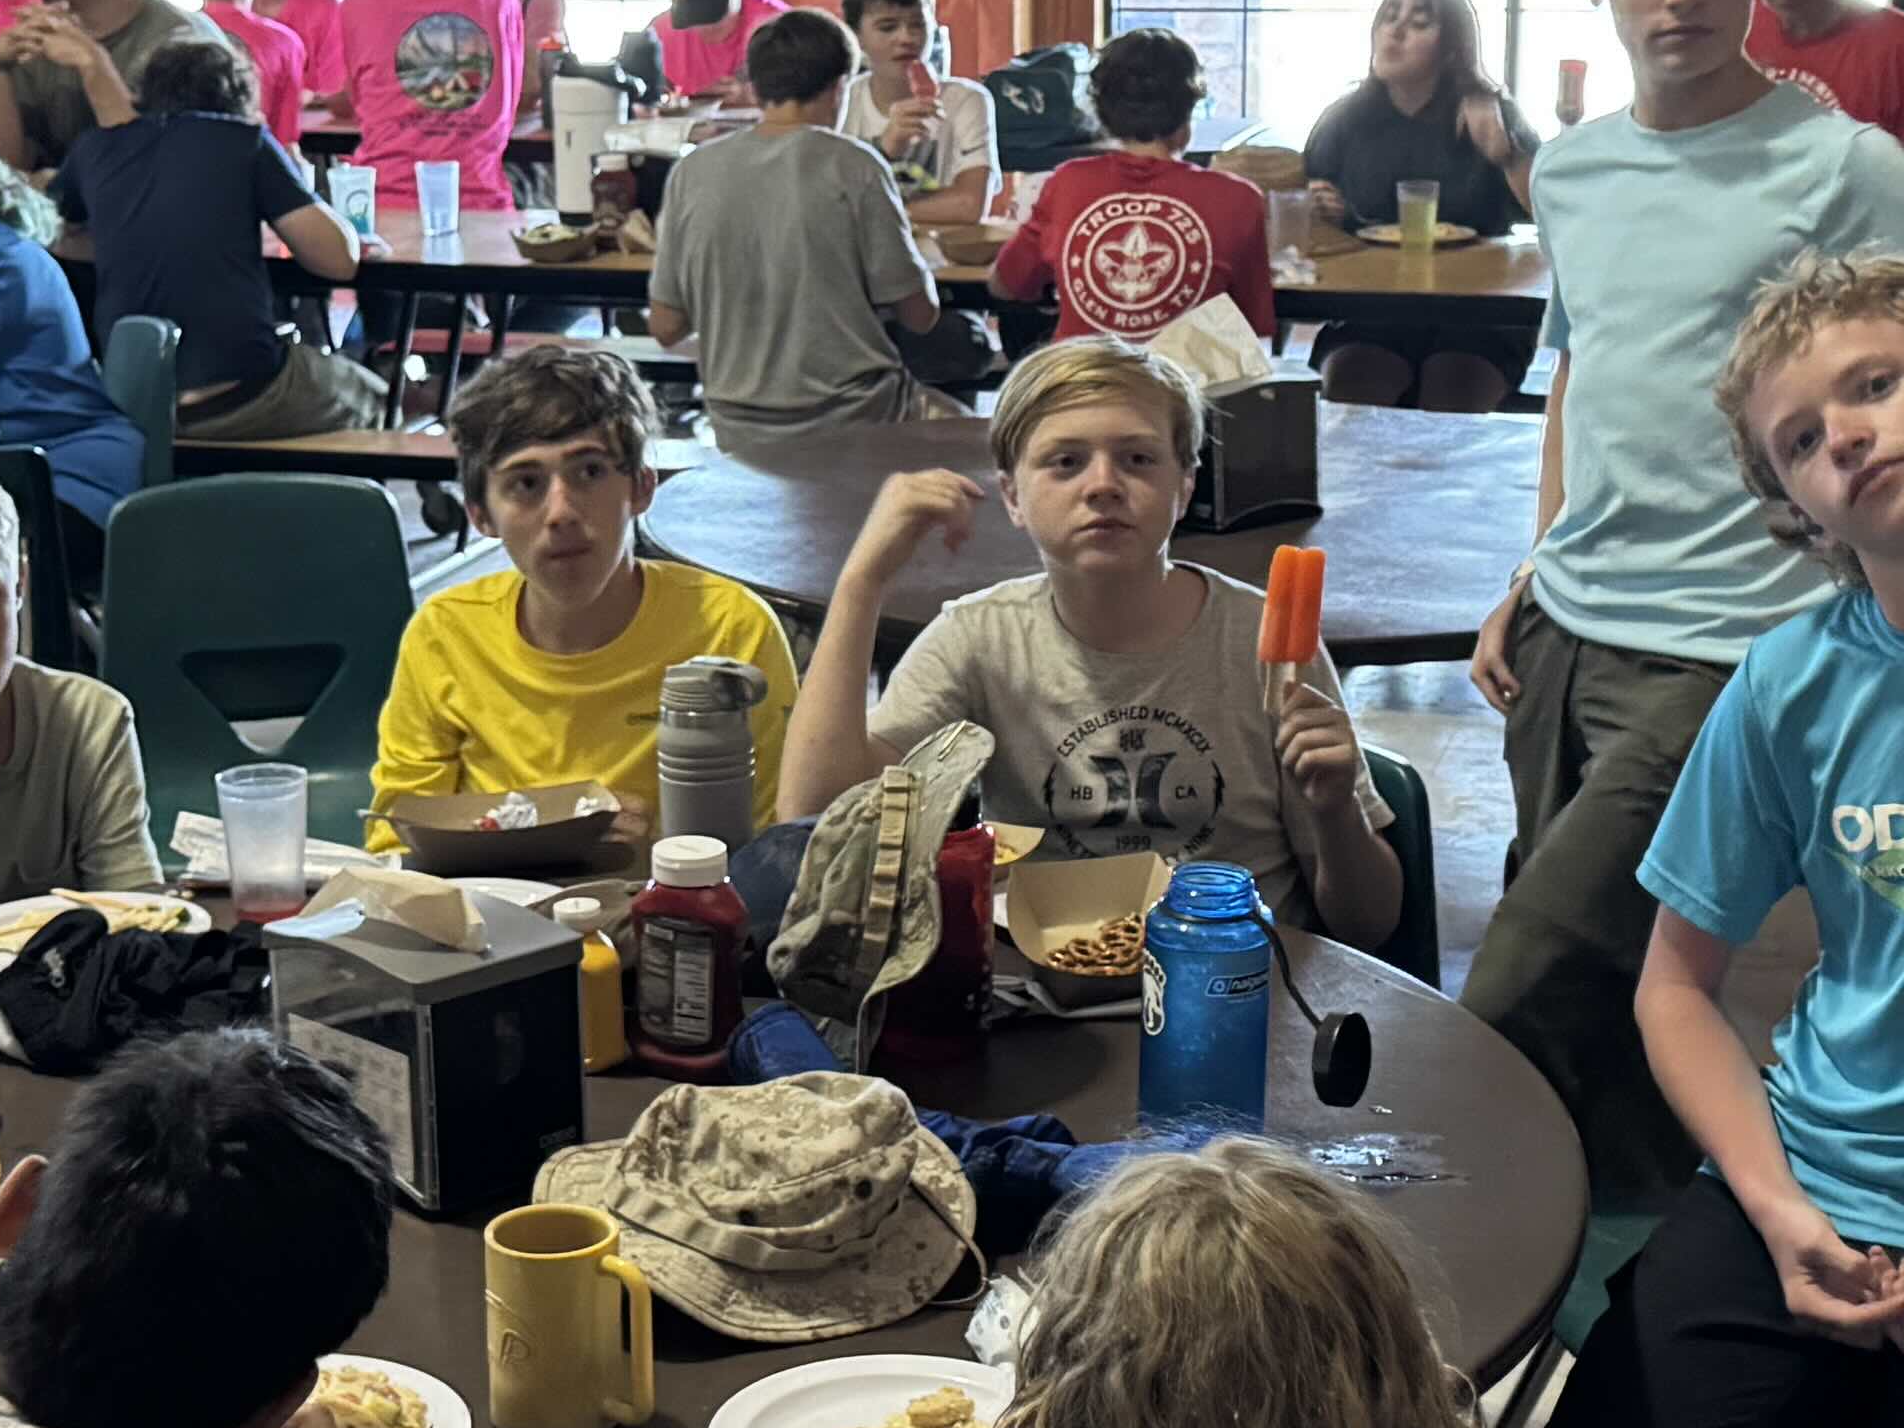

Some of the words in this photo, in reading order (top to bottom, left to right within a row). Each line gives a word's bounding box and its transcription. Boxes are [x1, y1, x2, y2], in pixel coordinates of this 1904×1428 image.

[1076, 201, 1162, 237] TROOP
[1072, 277, 1109, 320] GLEN
[1170, 284, 1194, 307] TX
[1057, 706, 1149, 757] ESTABLISHED
[1071, 785, 1093, 800] HB
[1175, 786, 1197, 800] CA
